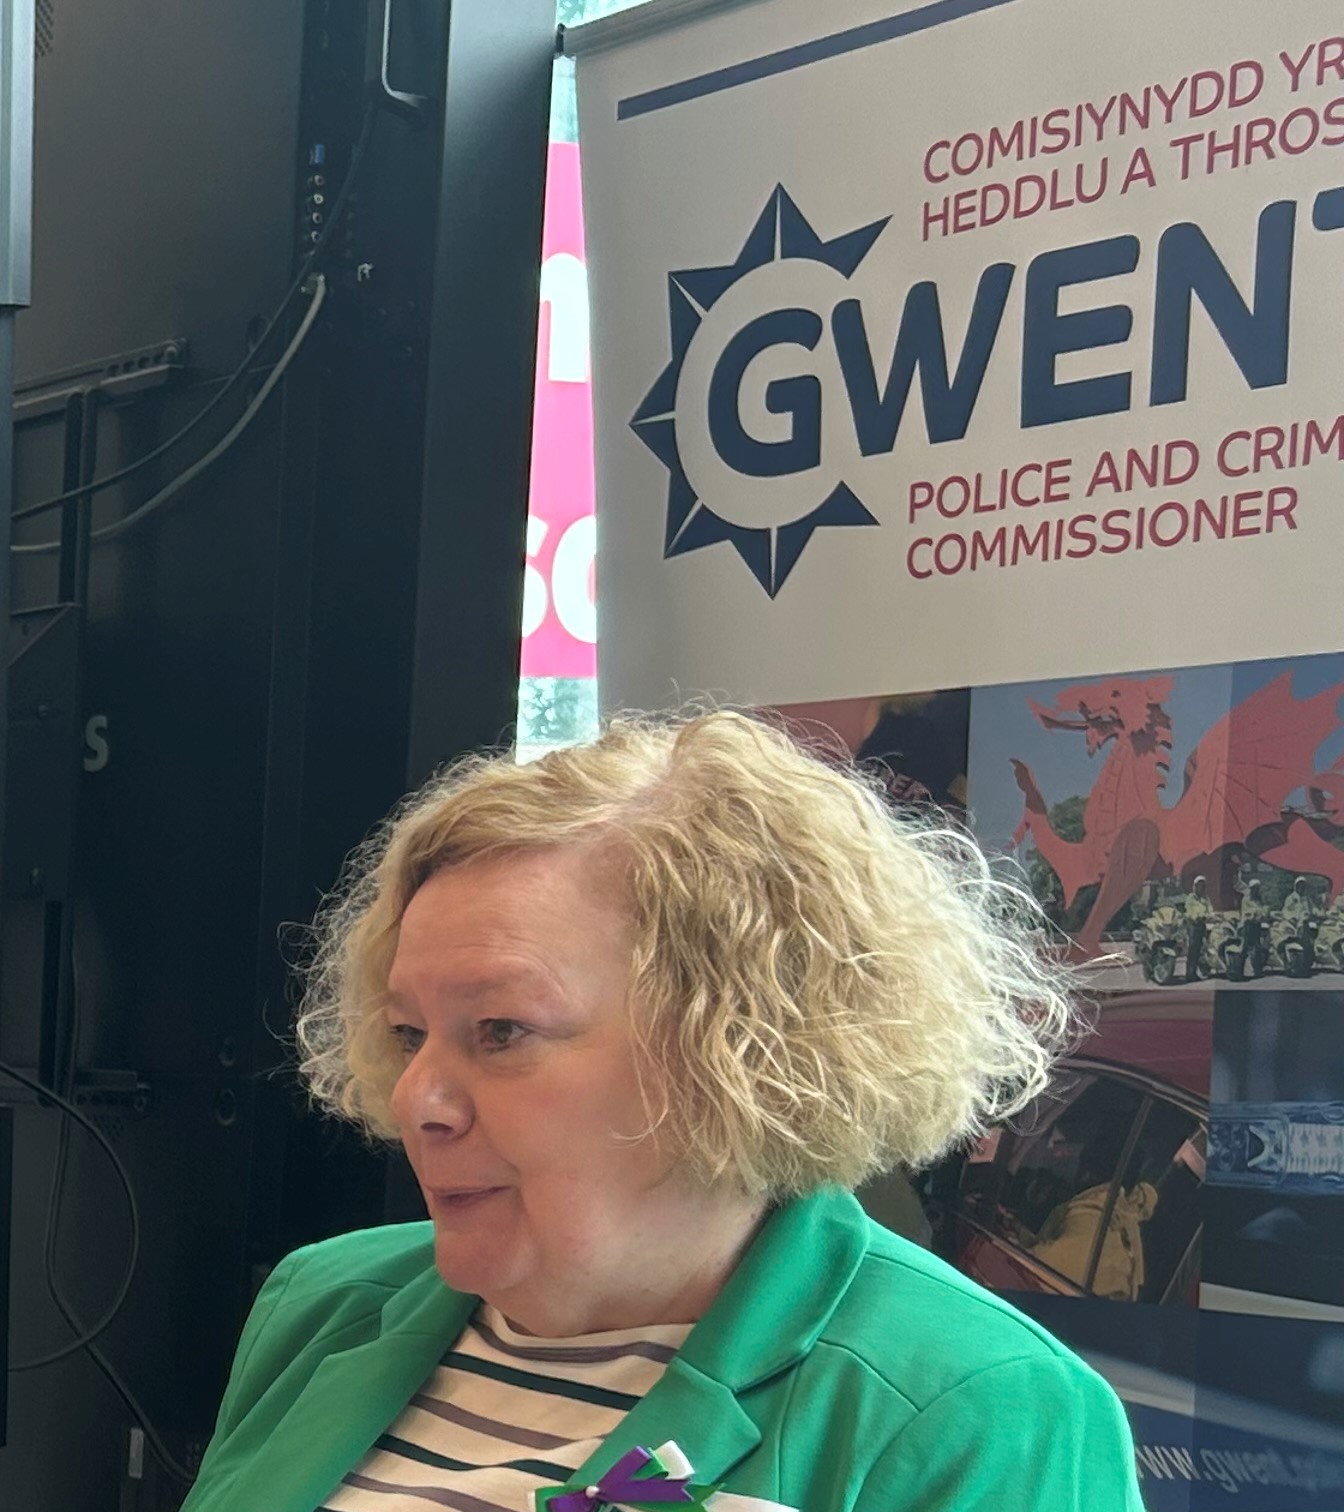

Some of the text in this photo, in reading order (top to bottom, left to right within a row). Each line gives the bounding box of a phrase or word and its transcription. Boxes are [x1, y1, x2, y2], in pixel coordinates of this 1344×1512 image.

[923, 36, 1344, 184] COMISIYNYDD YR
[921, 105, 1344, 242] HEDDLU A THROS
[908, 416, 1344, 525] POLICE AND CRIM
[906, 486, 1299, 579] COMMISSIONER
